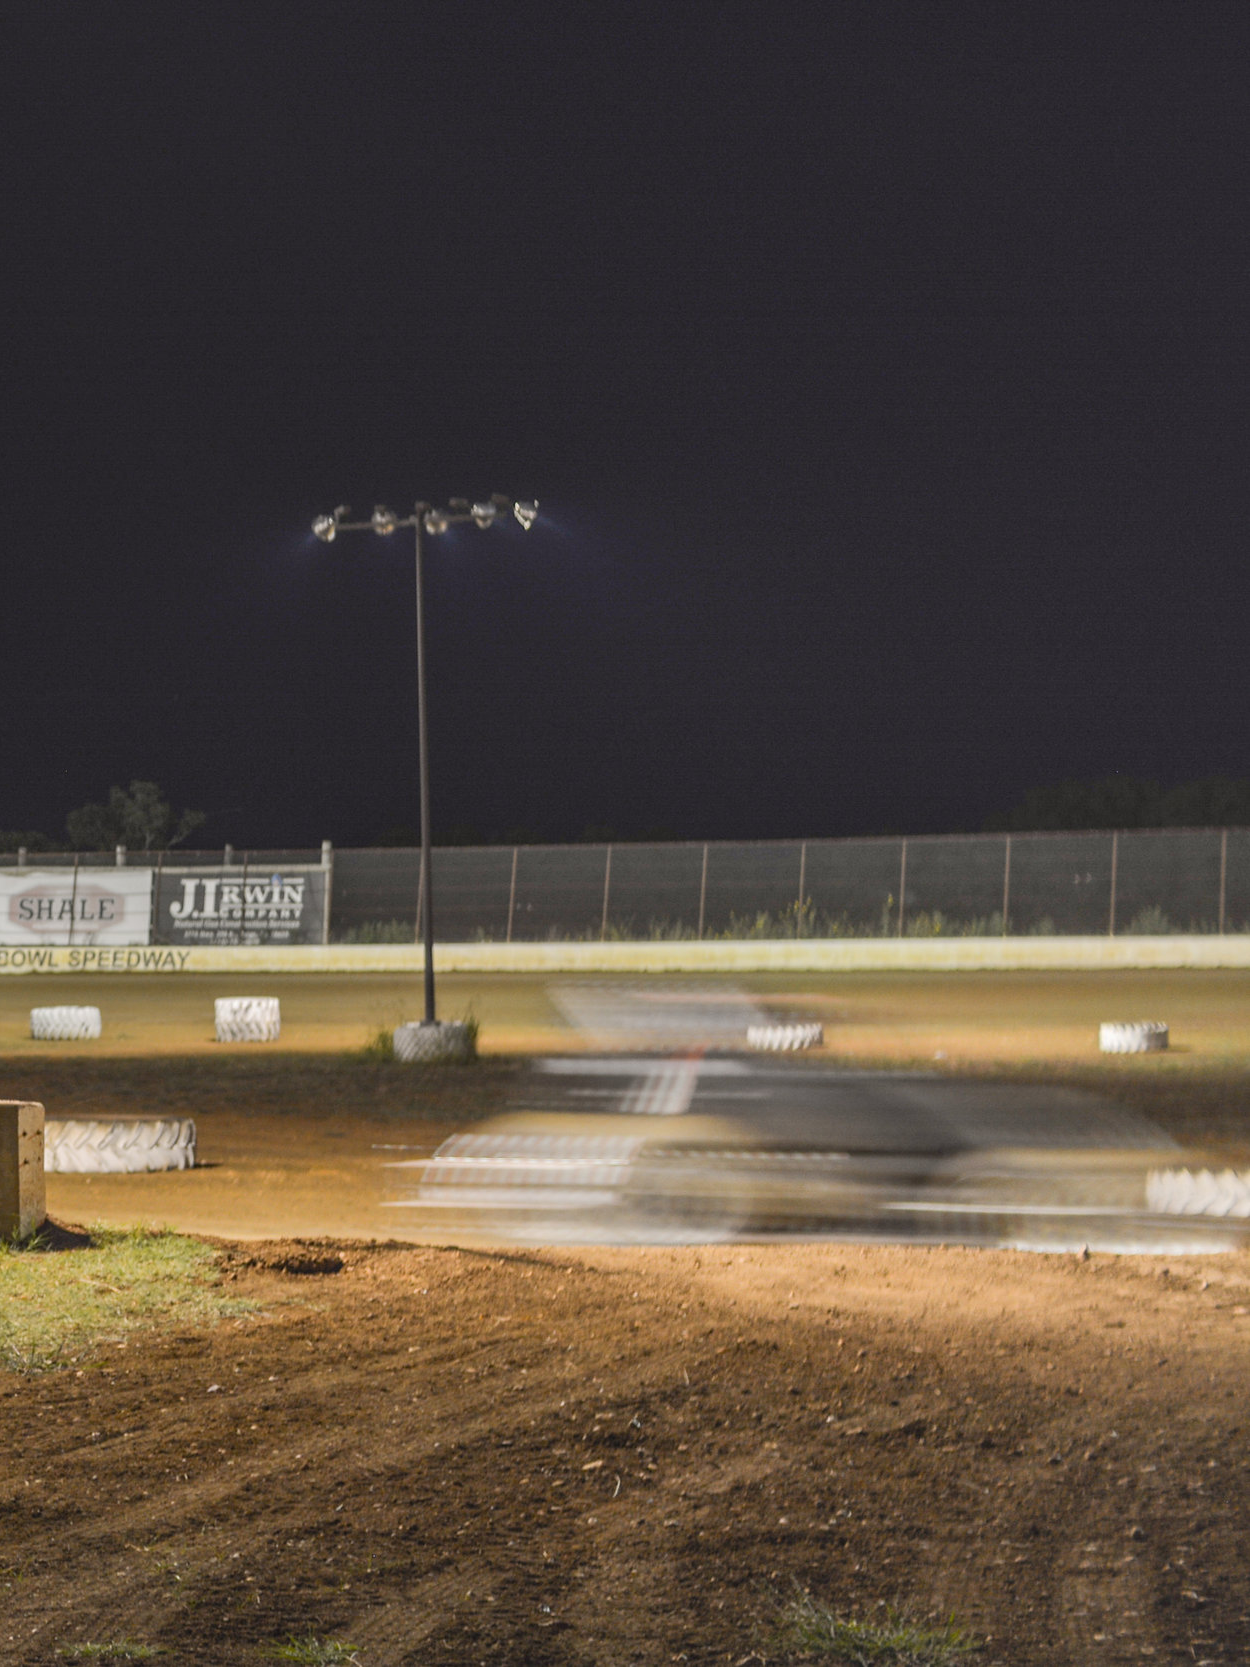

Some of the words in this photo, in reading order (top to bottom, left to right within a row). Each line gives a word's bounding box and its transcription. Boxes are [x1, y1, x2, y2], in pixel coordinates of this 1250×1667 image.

[18, 897, 116, 922] SHALE
[219, 906, 304, 920] COMPANY
[68, 950, 190, 970] SPEEDWAY
